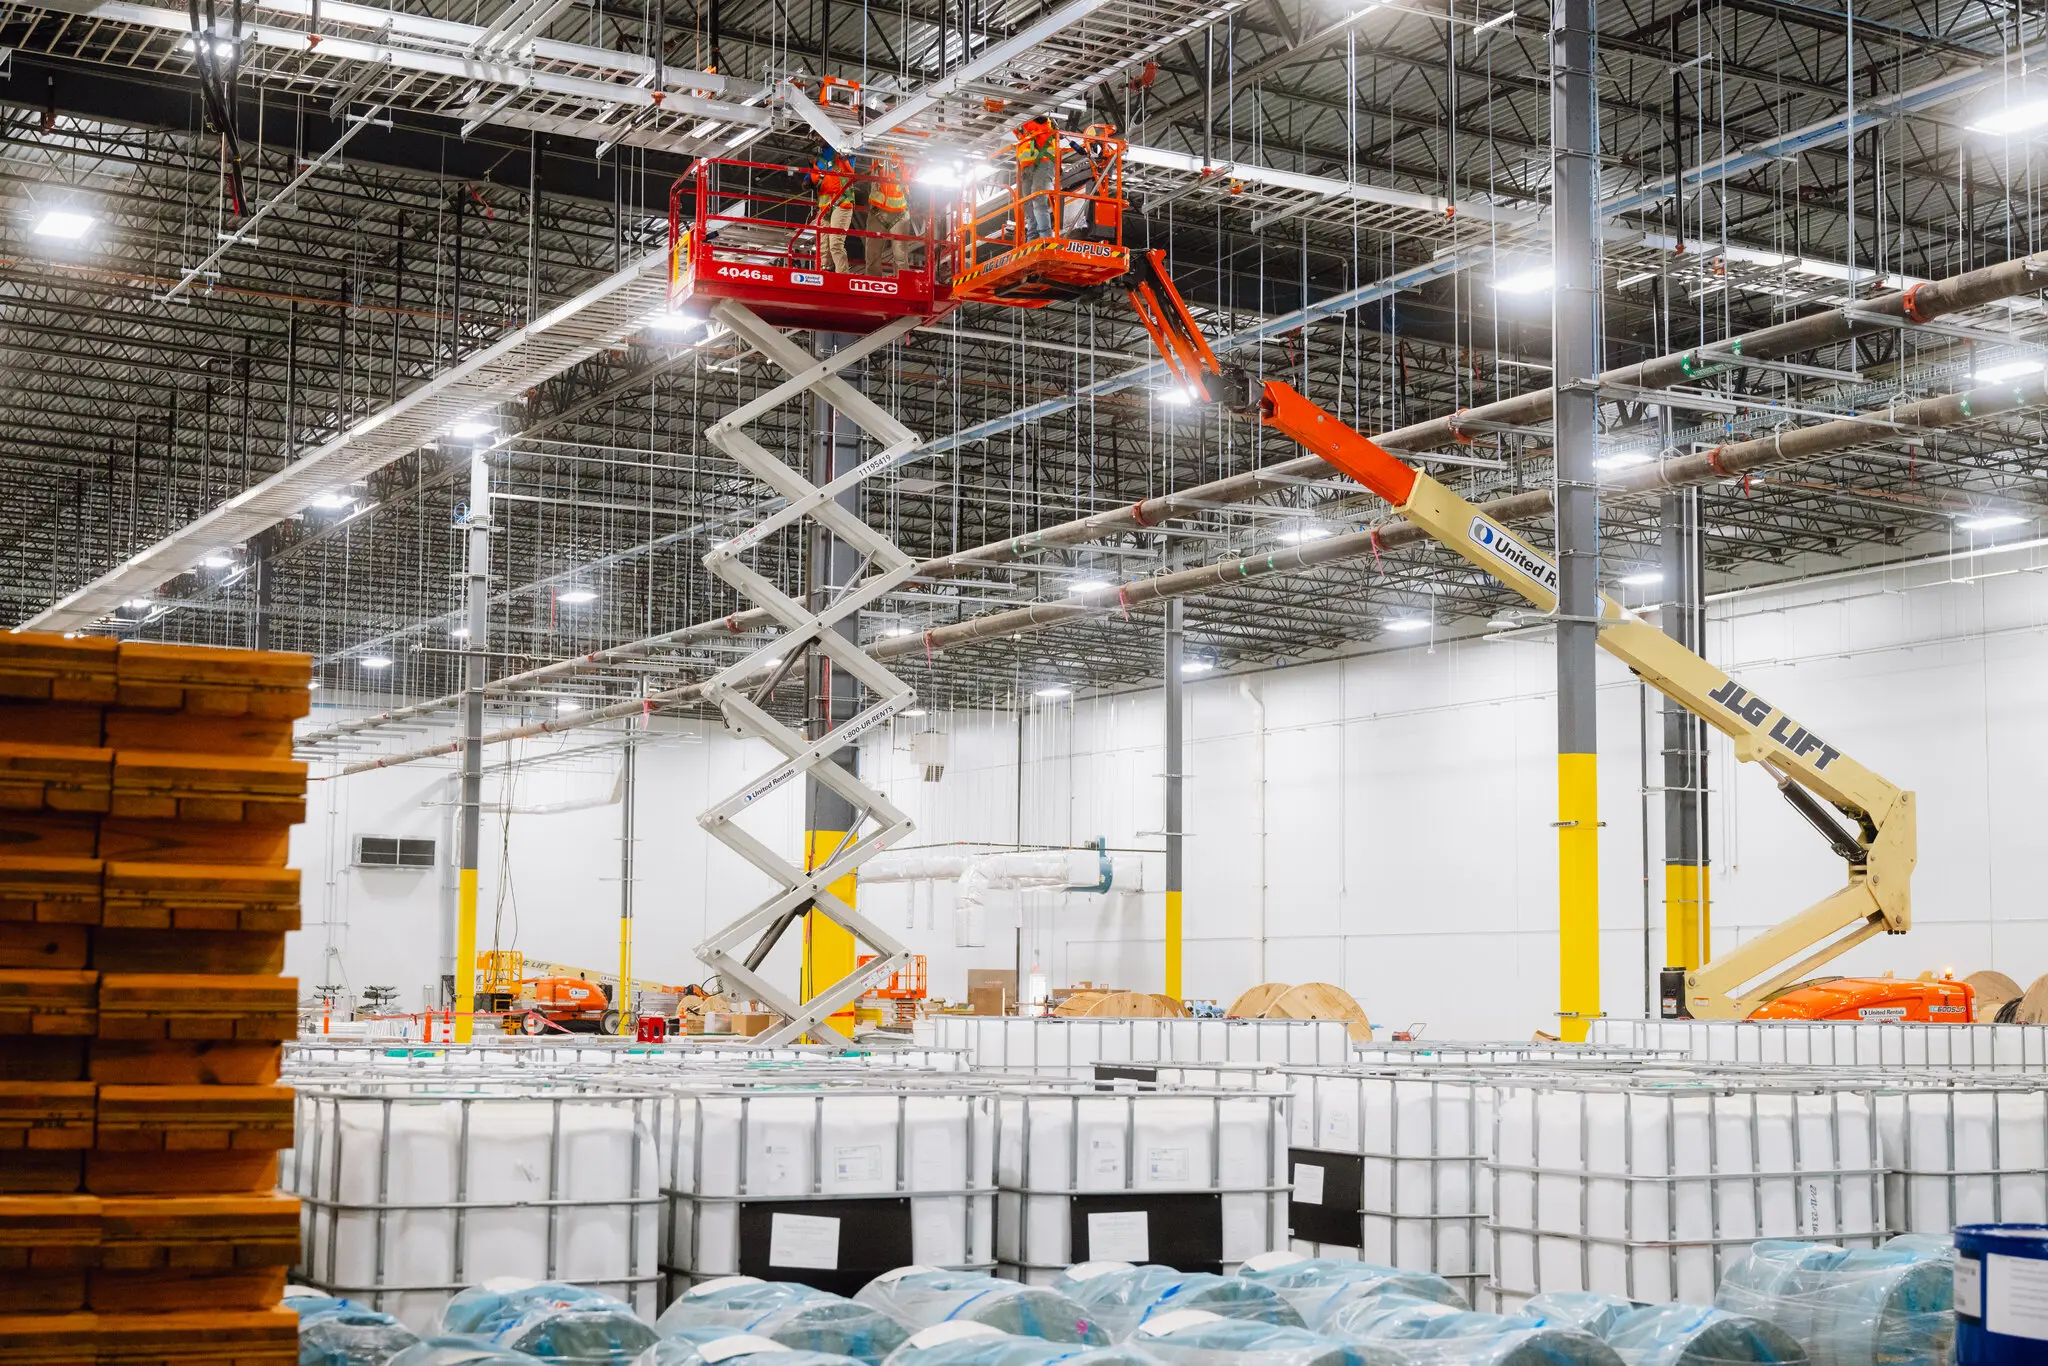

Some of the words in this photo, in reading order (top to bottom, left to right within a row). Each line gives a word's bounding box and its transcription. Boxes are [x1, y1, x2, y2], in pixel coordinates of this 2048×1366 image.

[1066, 242, 1110, 257] JibPLUS
[850, 280, 897, 293] mec
[859, 454, 891, 477] 11195419
[1494, 538, 1545, 578] United
[843, 705, 894, 741] 1-800-UR-RENTS
[1707, 680, 1773, 728] JLG
[1768, 715, 1841, 771] LIFT
[752, 782, 773, 798] United
[772, 768, 795, 785] Rentals
[531, 961, 552, 970] LIFT
